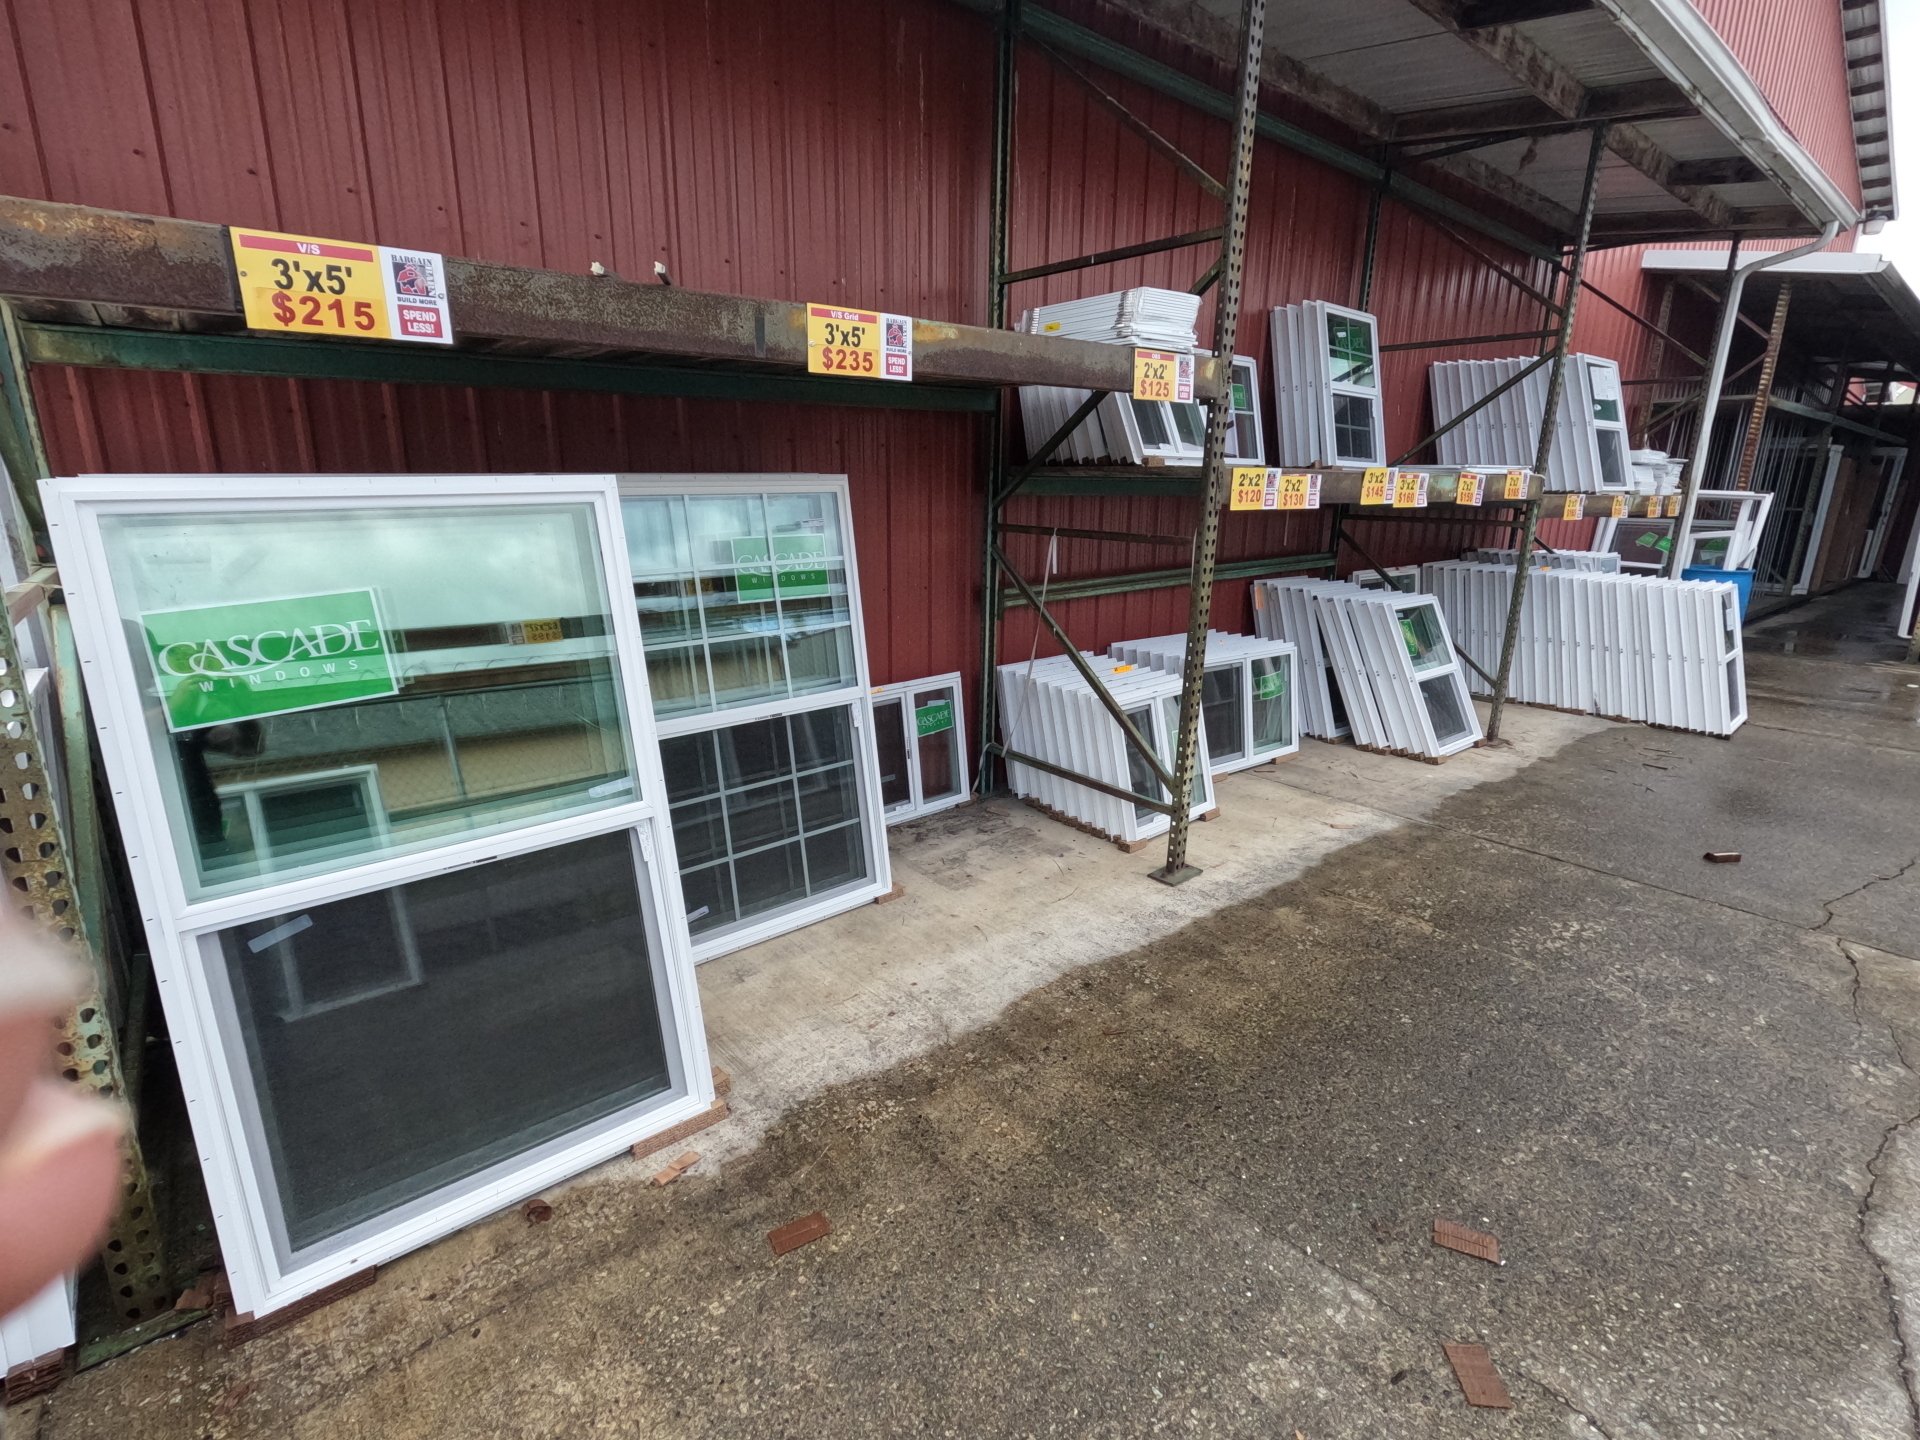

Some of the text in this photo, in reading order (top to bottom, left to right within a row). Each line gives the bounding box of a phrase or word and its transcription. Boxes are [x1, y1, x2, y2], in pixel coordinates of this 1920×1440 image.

[296, 243, 321, 256] V/S
[391, 254, 433, 266] BARGAIN
[271, 258, 353, 296] 3'x5'
[397, 296, 438, 306] BUILD MORE
[271, 290, 376, 331] $215
[403, 310, 437, 322] SPEND
[844, 312, 859, 321] Grid
[407, 321, 435, 334] LESS!
[825, 323, 866, 347] 3'x5'
[822, 346, 874, 372] $235
[1144, 362, 1168, 380] 2'x2'
[1140, 379, 1170, 397] $125
[1237, 489, 1262, 503] $120
[1283, 493, 1304, 506] $130
[751, 573, 816, 584] WIDOWS
[158, 619, 380, 678] CASCADE
[198, 659, 358, 693] WINDOWS
